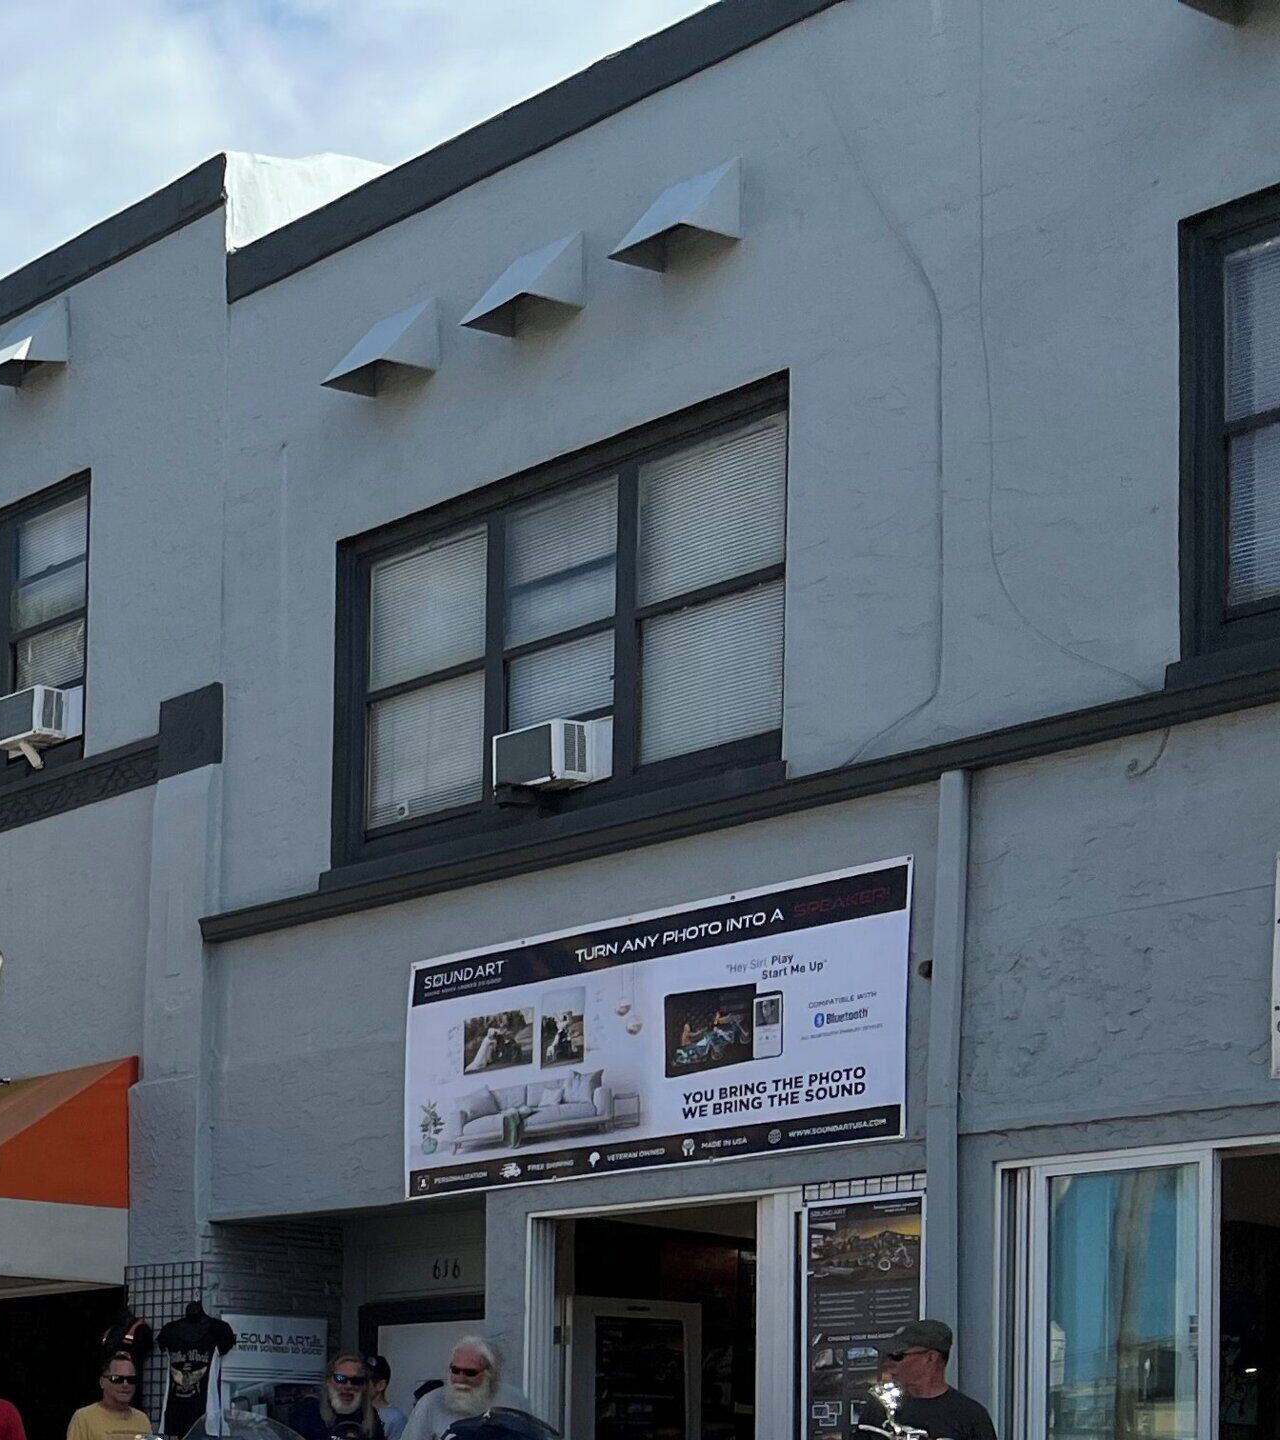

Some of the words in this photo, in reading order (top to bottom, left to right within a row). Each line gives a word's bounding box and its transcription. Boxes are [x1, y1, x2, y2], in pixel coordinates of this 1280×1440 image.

[575, 941, 618, 963] TURN
[620, 933, 660, 955] ANY
[662, 920, 723, 946] PHOTO
[726, 911, 767, 933] INTO
[770, 908, 784, 923] A
[771, 953, 794, 966] Play
[424, 967, 474, 990] SOUND
[474, 960, 505, 979] ART
[761, 967, 788, 980] Start
[790, 963, 806, 976] Me
[826, 1007, 869, 1025] Bluetooth
[683, 1089, 715, 1105] YOU
[719, 1081, 768, 1102] BRING
[772, 1075, 804, 1093] THE
[808, 1066, 867, 1089] PHOTO
[682, 1103, 708, 1120] WE
[712, 1096, 763, 1116] BRING
[767, 1090, 800, 1108] THE
[804, 1081, 867, 1103] SOUND
[701, 1138, 722, 1149] MADE
[732, 1136, 748, 1146] USA
[433, 1257, 460, 1280] 616
